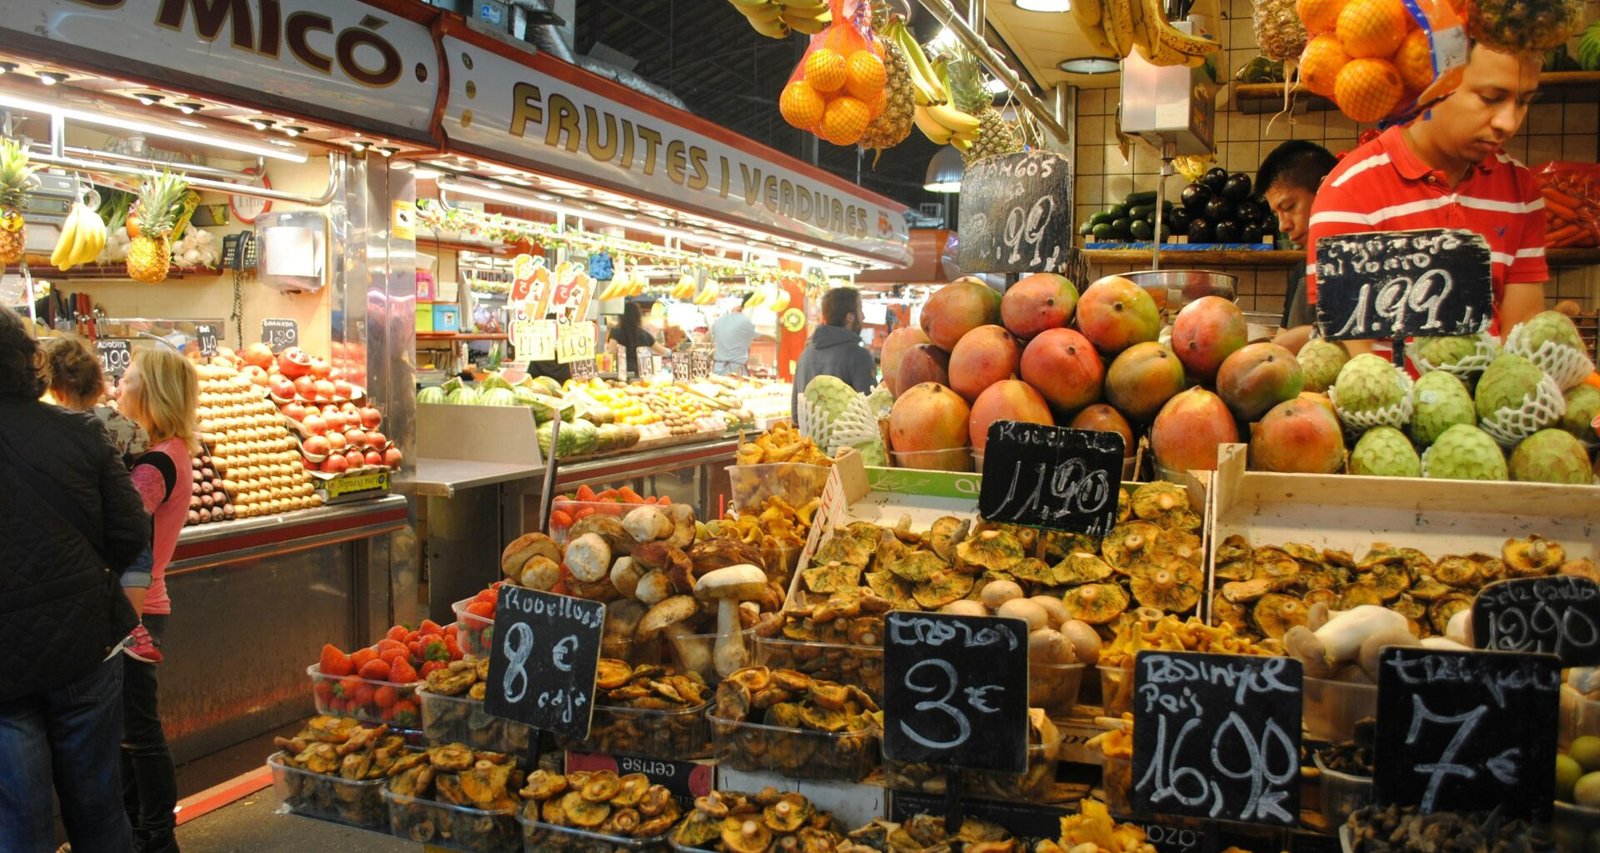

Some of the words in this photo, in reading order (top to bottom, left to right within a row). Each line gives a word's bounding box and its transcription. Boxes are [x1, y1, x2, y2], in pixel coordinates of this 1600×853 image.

[509, 81, 708, 190] FRUITES
[719, 156, 730, 198] I
[740, 163, 868, 238] VERDURES
[503, 621, 534, 703] 8
[552, 634, 579, 672] €
[900, 658, 971, 749] 3
[963, 685, 1005, 713] €
[622, 757, 676, 777] cerise
[1405, 693, 1489, 814] 7
[1486, 748, 1520, 785] €
